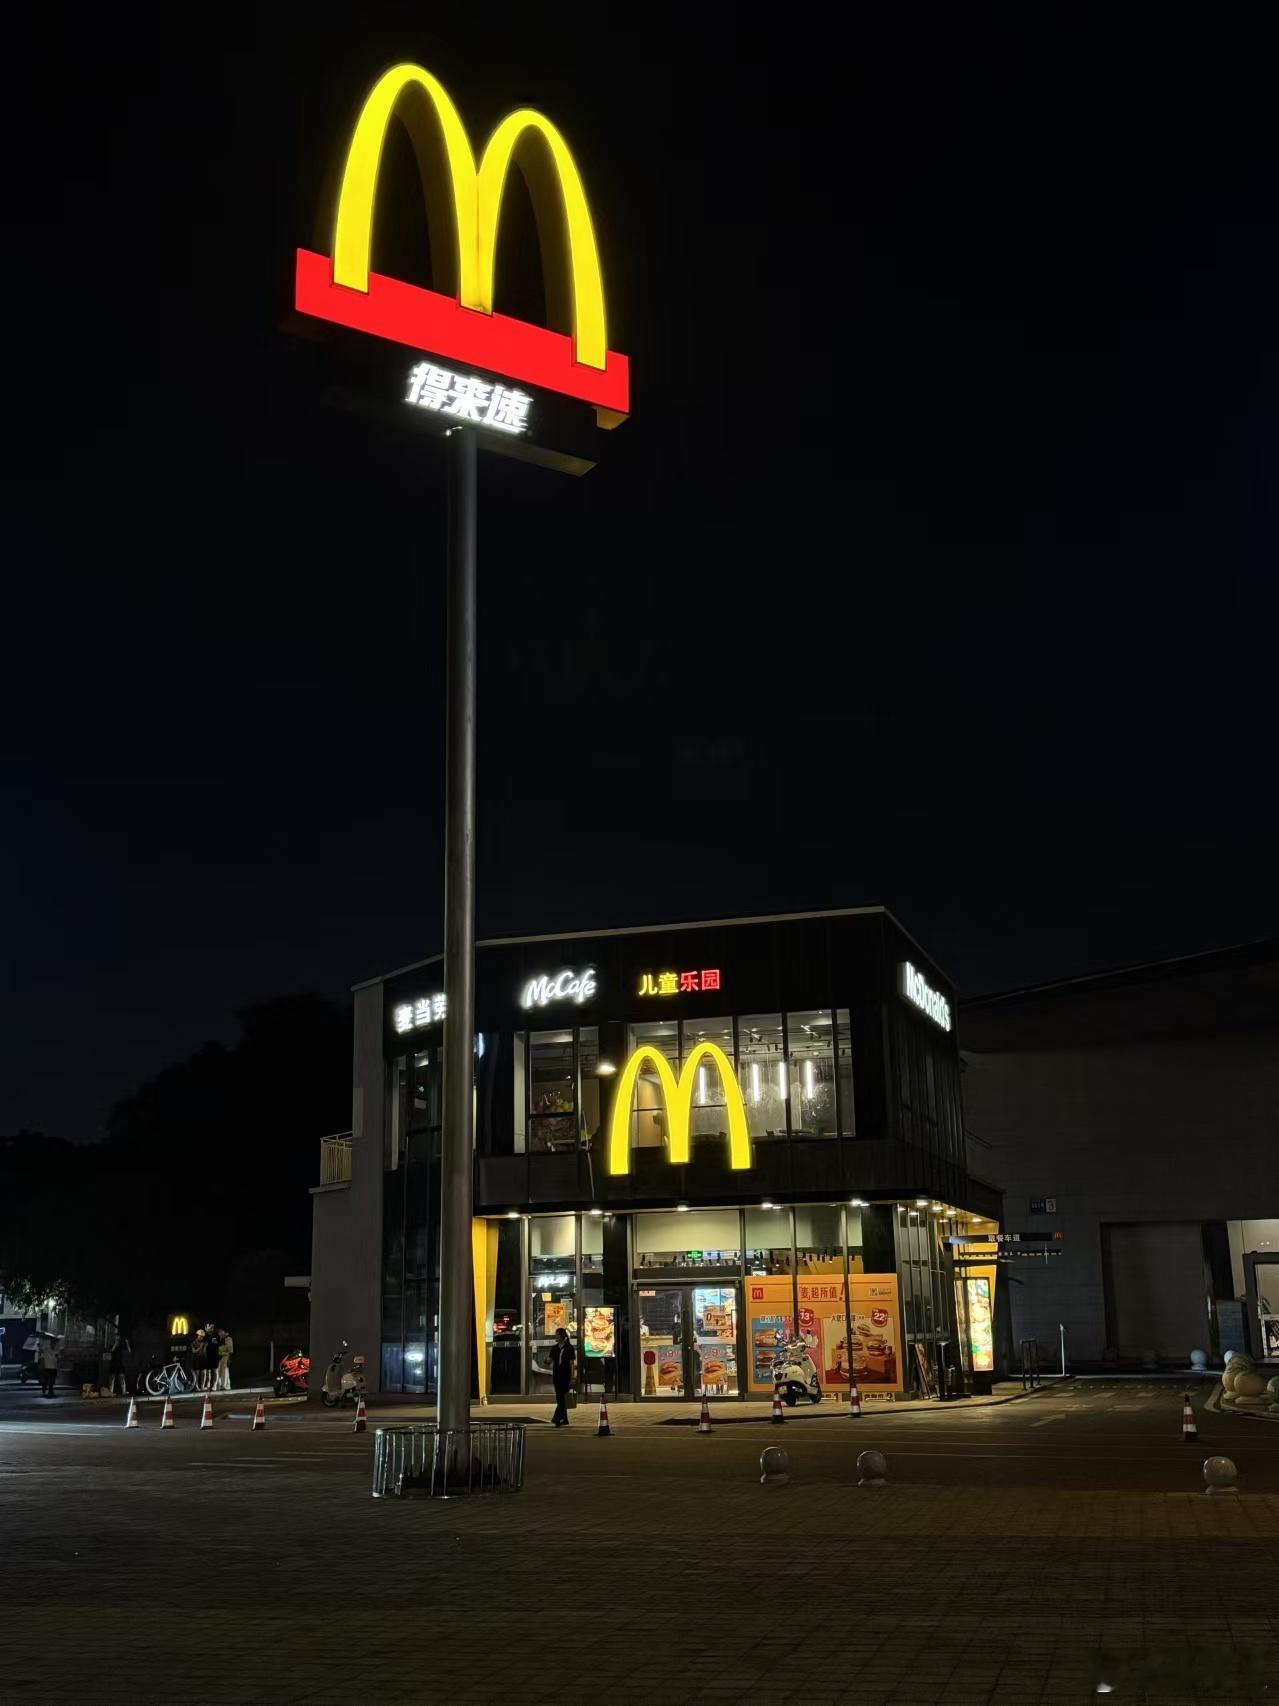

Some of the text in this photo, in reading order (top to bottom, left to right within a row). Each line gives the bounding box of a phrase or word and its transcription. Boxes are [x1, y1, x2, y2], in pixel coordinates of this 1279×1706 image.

[405, 361, 534, 434] 得来速
[638, 969, 721, 996] 儿童乐园
